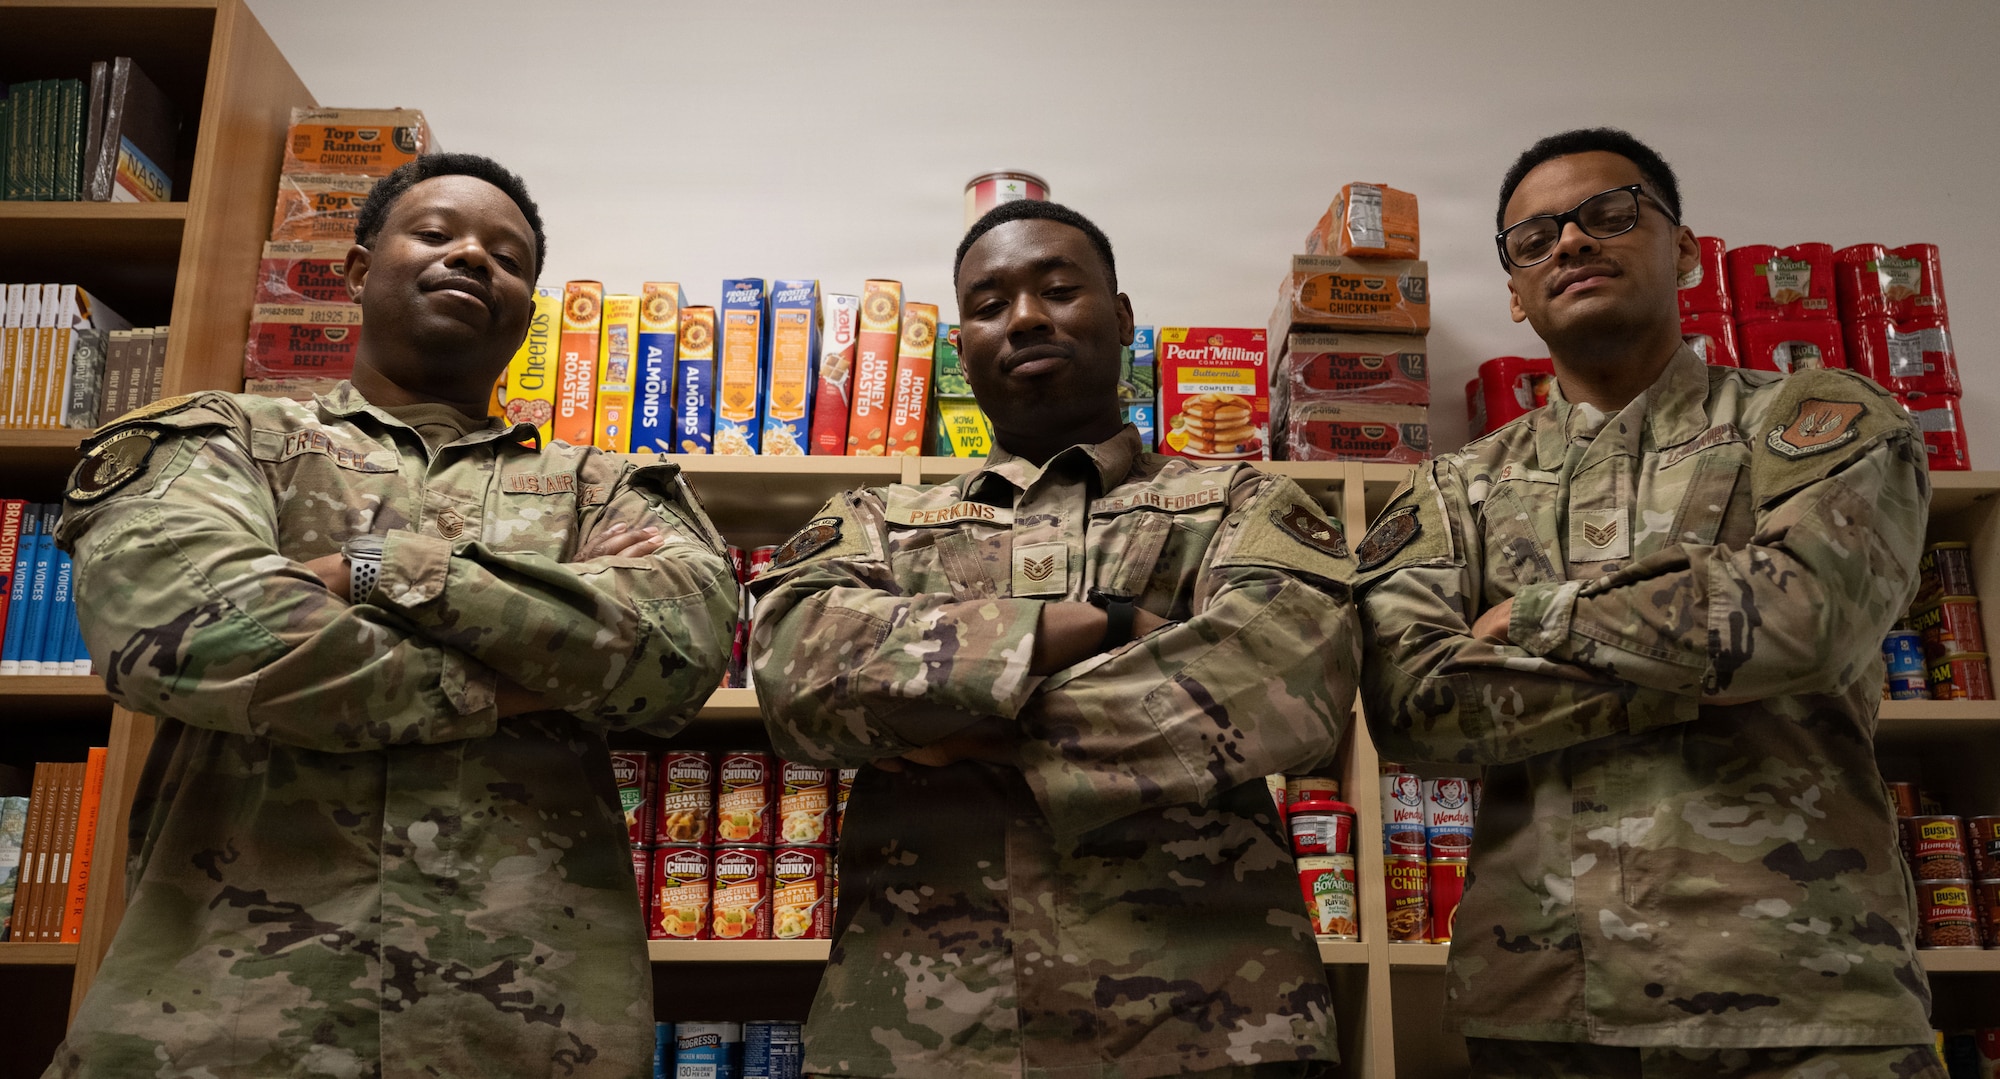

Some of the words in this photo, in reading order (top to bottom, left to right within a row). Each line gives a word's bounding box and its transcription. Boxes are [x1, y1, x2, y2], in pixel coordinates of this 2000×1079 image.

[324, 128, 354, 142] Top
[323, 140, 382, 152] Ramen
[320, 153, 368, 165] CHICKEN
[128, 154, 164, 198] NASB
[316, 193, 348, 208] Top
[300, 262, 330, 277] Top
[298, 274, 344, 287] Rame
[1328, 276, 1361, 292] Top
[1409, 279, 1422, 293] 12
[726, 289, 758, 298] FROSTED
[728, 296, 756, 304] FLAKES
[777, 289, 809, 298] FROSTED
[778, 296, 807, 304] FLAKES
[1330, 288, 1392, 302] Ramen
[1329, 302, 1378, 314] CHICKEN
[289, 325, 322, 341] Top
[835, 308, 850, 344] Chex
[1136, 331, 1146, 343] 6
[289, 340, 350, 352] Ramen
[520, 313, 550, 390] Cheerios
[293, 355, 328, 366] BEEF
[1166, 344, 1208, 360] Pearl
[1210, 346, 1264, 366] Milling
[1327, 354, 1360, 370] Top
[1407, 355, 1422, 369] 12
[110, 370, 120, 388] HOLY
[130, 368, 141, 387] HOLY
[154, 367, 164, 385] HOLY
[1192, 369, 1241, 378] Buttermilk
[1329, 368, 1390, 380] Ramen
[561, 352, 578, 418] ROASTED
[576, 360, 592, 410] HONEY
[642, 345, 663, 428] ALMONDS
[857, 351, 875, 417] ROASTED
[872, 360, 888, 410] HONEY
[73, 383, 85, 409] BIBLE
[106, 390, 117, 412] BIBLE
[127, 388, 138, 410] BIBLE
[685, 366, 699, 436] ALMONDS
[895, 368, 912, 426] ROASTED
[910, 376, 925, 420] HONEY
[1135, 408, 1146, 420] 6
[956, 426, 979, 434] VALUE
[1328, 424, 1361, 439] Top
[1409, 426, 1424, 440] 12
[960, 436, 983, 447] CAN
[1331, 438, 1392, 450] Ramen
[546, 473, 575, 492] AIR
[1132, 492, 1160, 506] AIR
[1165, 488, 1220, 509] FORCE
[909, 503, 995, 523] PERKINS
[0, 502, 21, 572] BRAINSTORM
[12, 568, 26, 601] VOICES
[32, 568, 46, 601] VOICES
[55, 569, 69, 602] VOICES
[1912, 608, 1941, 632] SPAM
[670, 768, 709, 782] CHUNKY
[722, 768, 761, 781] CHUNKY
[785, 770, 824, 782] CHUNKY
[665, 793, 696, 804] STEAK
[720, 797, 764, 808] NOODLE
[806, 800, 817, 808] POT
[666, 801, 711, 811] POTATO
[1433, 810, 1469, 826] Wendy's
[1924, 826, 1954, 836] BUSH'S
[1920, 842, 1962, 852] Homestyle
[667, 861, 707, 875] CHUNKY
[716, 863, 755, 876] CHUNKY
[775, 862, 812, 875] CHUNKY
[1384, 864, 1427, 877] Hormel
[1318, 873, 1332, 882] Chef
[1391, 878, 1424, 891] Chili
[73, 860, 89, 916] POWER
[662, 889, 687, 897] CLASSIC
[1313, 881, 1355, 894] BOYARDEE
[663, 894, 709, 903] NOODLE
[793, 893, 806, 902] POT
[806, 892, 816, 901] PIE
[1325, 899, 1350, 908] Ravioli
[1396, 898, 1406, 906] No
[1408, 896, 1424, 906] Beans
[1936, 892, 1966, 902] BUSH'S
[1932, 907, 1972, 917] Homestyle
[678, 1035, 718, 1049] PROGRESSO
[679, 1066, 691, 1077] 130
